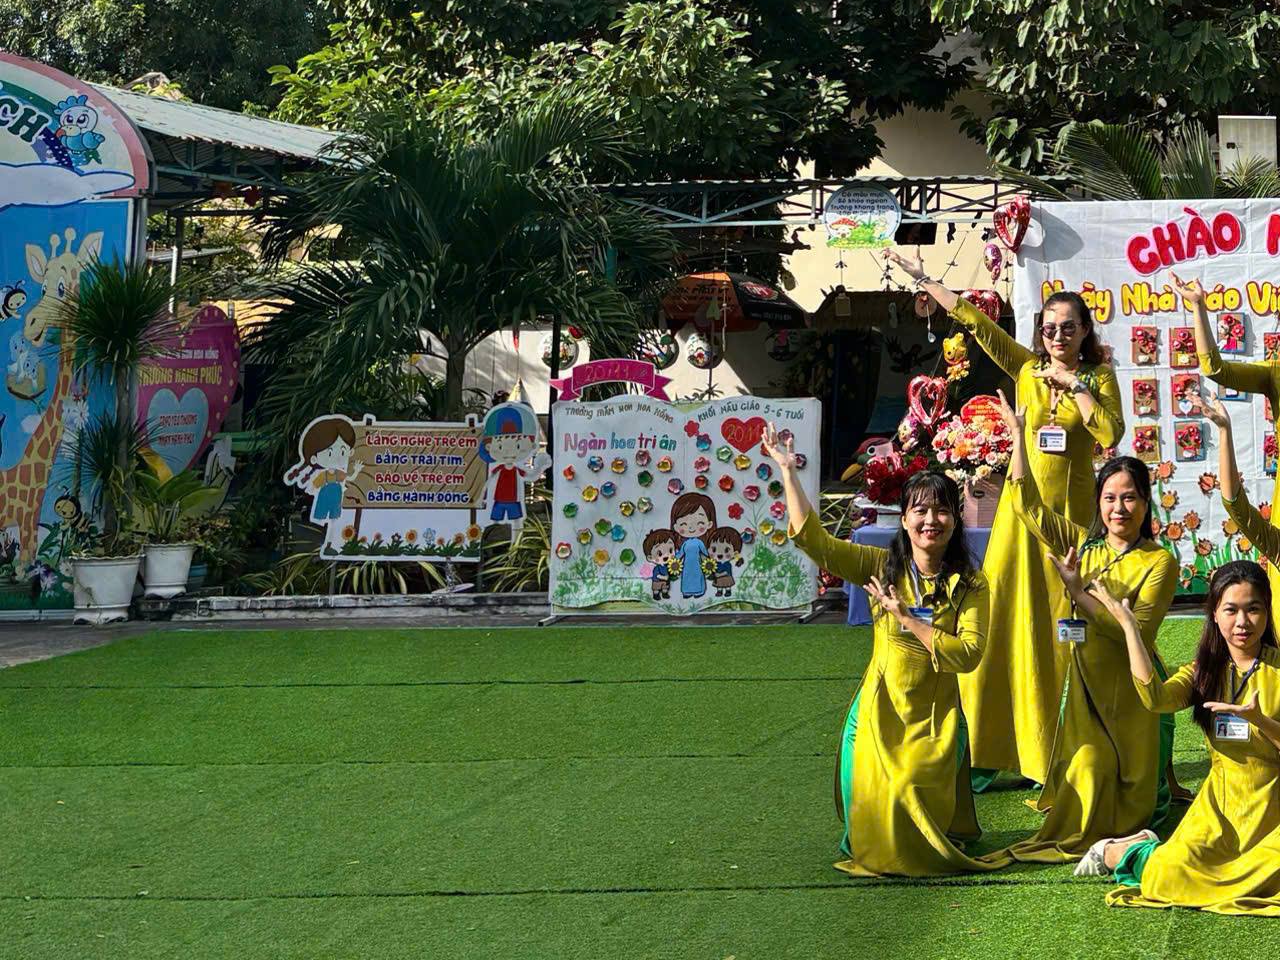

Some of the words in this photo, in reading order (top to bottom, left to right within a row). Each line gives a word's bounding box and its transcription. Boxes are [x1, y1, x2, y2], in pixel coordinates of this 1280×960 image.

[1127, 205, 1242, 276] CHÀO
[1121, 281, 1177, 315] Nhà
[740, 400, 760, 412] GIÁO
[563, 432, 607, 459] Ngàn
[610, 431, 636, 449] hoa
[637, 432, 657, 449] tri
[658, 433, 677, 451] ân
